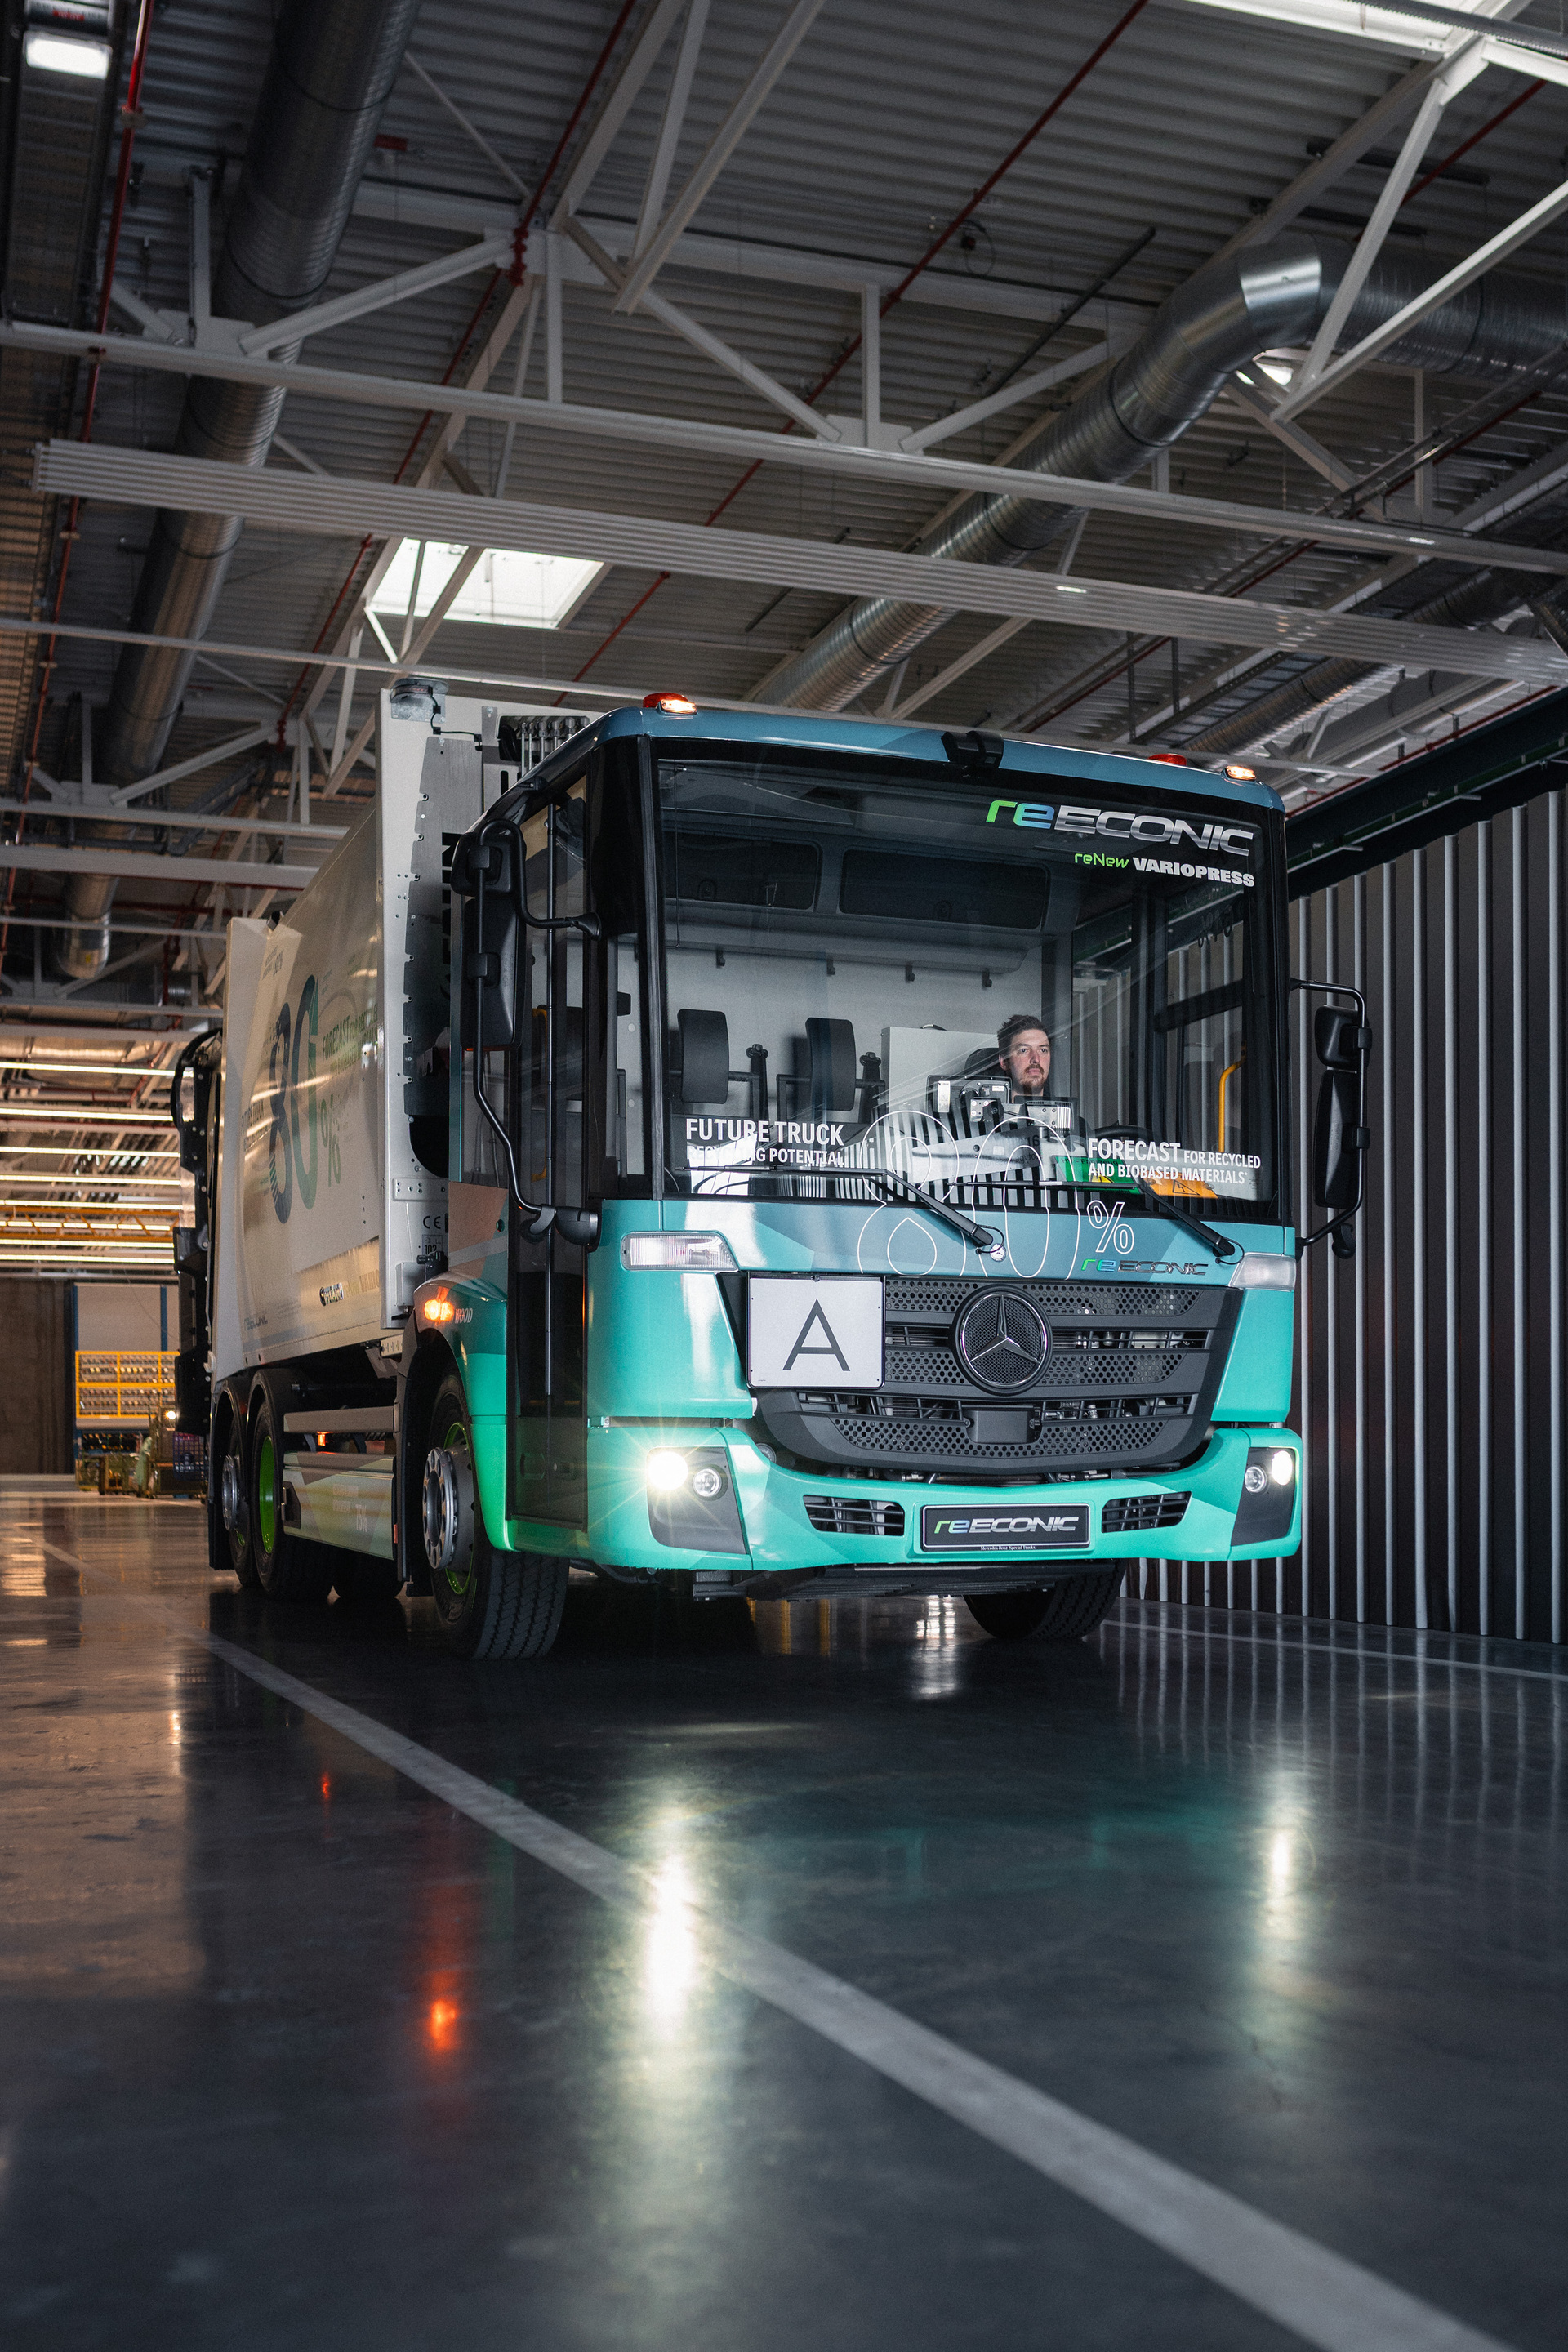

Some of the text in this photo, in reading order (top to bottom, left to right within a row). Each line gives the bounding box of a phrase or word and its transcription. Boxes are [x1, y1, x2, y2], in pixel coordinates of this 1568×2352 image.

[1074, 853, 1255, 887] reNew VARIOPRESS
[686, 1118, 844, 1146] FUTURE TRUCK
[769, 1148, 844, 1165] POTENTIAL
[1088, 1138, 1181, 1162] FORECAST
[1183, 1150, 1206, 1166] FOR
[1208, 1152, 1261, 1169] RECYCLED
[1088, 1162, 1115, 1178] AND
[1118, 1164, 1178, 1181] BIOBASED
[782, 1298, 851, 1372] A
